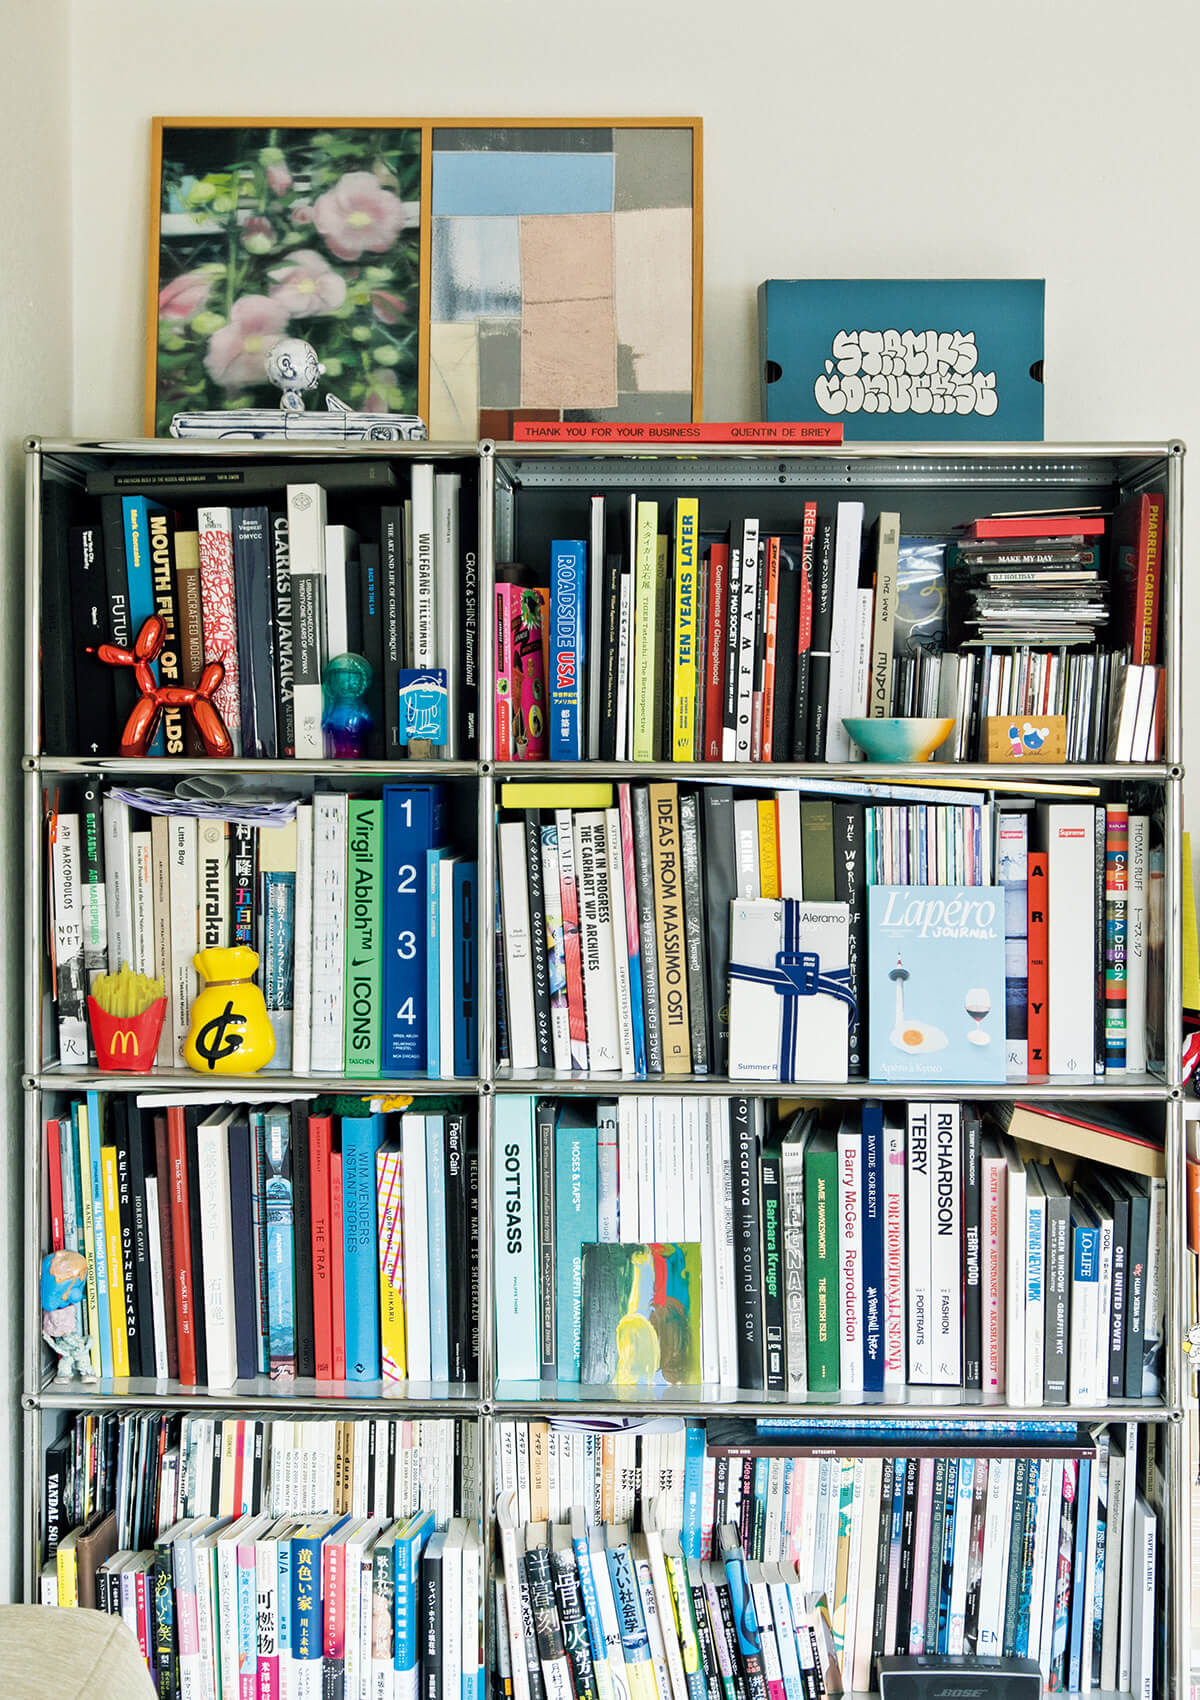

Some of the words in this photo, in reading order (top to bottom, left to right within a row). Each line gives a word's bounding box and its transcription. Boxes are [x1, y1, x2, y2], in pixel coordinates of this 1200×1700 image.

[525, 428, 559, 437] THANK
[563, 428, 587, 437] YOU
[591, 428, 610, 437] FOR
[616, 428, 644, 437] YOUR
[648, 428, 700, 437] BUSINESS
[731, 428, 777, 437] QUENTIN
[782, 428, 796, 437] DE
[801, 428, 831, 437] BRIEY
[273, 518, 291, 593] CLARKS
[681, 515, 693, 566] LATER
[1036, 554, 1053, 562] DAY
[418, 534, 430, 595] WOLFGANG
[465, 552, 475, 588] CRACK
[731, 549, 739, 580] SABER
[150, 516, 170, 591] MOUTH
[161, 652, 177, 678] OF
[186, 575, 197, 635] HANDCRAFTED
[277, 597, 291, 617] IN
[389, 588, 395, 597] OF
[557, 555, 575, 647] ROADSIDE
[679, 573, 692, 628] YEARS
[713, 565, 723, 616] Compliments
[730, 595, 738, 613] MAD
[419, 599, 431, 655] TILLMANS
[466, 598, 475, 627] SHINE
[714, 619, 722, 627] of
[679, 634, 691, 665] TEN
[729, 615, 737, 648] SOCIETY
[190, 638, 200, 672] MODERN
[276, 620, 295, 703] JAMAICA
[465, 629, 476, 686] International
[557, 653, 575, 688] USA
[711, 629, 721, 685] Chicagohoodz
[401, 799, 412, 827] 1
[657, 799, 675, 847] IDEAS
[60, 825, 70, 840] ARI
[177, 826, 185, 848] Little
[351, 810, 375, 862] Virgil
[580, 825, 591, 843] THE
[1059, 829, 1085, 838] Supreme
[1133, 823, 1143, 864] THOMAS
[177, 850, 186, 866] Boy
[582, 847, 595, 897] CARHARTT
[660, 852, 677, 899] FROM
[62, 845, 73, 910] MARCOPOULOS
[236, 823, 252, 947] 村上隆の五百羅
[398, 865, 417, 893] 2
[1113, 854, 1125, 930] CALIFRNIA
[1133, 868, 1143, 890] RUFF
[585, 901, 596, 920] WIP
[59, 925, 80, 934] NOT
[60, 937, 80, 946] YET
[397, 931, 416, 959] 3
[586, 924, 599, 971] ARCHIVES
[662, 904, 681, 984] MASSIMO
[1113, 935, 1123, 981] DESIGN
[353, 977, 371, 1050] ICONS
[397, 997, 416, 1024] 4
[667, 990, 683, 1026] OSTI
[738, 1063, 770, 1071] Summer
[736, 1099, 749, 1123] roy
[449, 1123, 459, 1149] Peter
[868, 1135, 877, 1168] DAVIDE
[912, 1114, 927, 1175] TERRY
[119, 1150, 129, 1204] PETER
[346, 1144, 357, 1197] INSTANT
[359, 1152, 369, 1181] WIM
[450, 1152, 460, 1175] Cain
[740, 1133, 752, 1207] decarava
[843, 1148, 856, 1186] Barry
[938, 1113, 953, 1236] RICHARDSON
[505, 1143, 522, 1254] SOTTSASS
[817, 1178, 825, 1200] JAMIE
[868, 1172, 877, 1218] SORRENTI
[888, 1193, 901, 1220] FOR
[135, 1196, 143, 1229] HORROR
[316, 1219, 324, 1242] THE
[347, 1201, 358, 1253] STORIES
[359, 1184, 370, 1245] WENDERS
[742, 1215, 754, 1238] the
[766, 1199, 777, 1251] Barbara
[817, 1202, 826, 1258] HAWKESWORTH
[844, 1191, 857, 1239] McGee
[136, 1231, 145, 1262] CAVIAR
[1058, 1220, 1066, 1252] BROKEN
[1081, 1232, 1092, 1277] LO-LIFE
[1103, 1229, 1111, 1251] POOL
[316, 1248, 325, 1279] TRAP
[743, 1247, 757, 1292] sound
[887, 1222, 902, 1313] PROMOTIONAL
[967, 1226, 978, 1285] TERRYWOOD
[1057, 1254, 1065, 1293] WINDOWS
[1114, 1246, 1124, 1268] ONE
[123, 1228, 136, 1336] SUTHERLAND
[766, 1253, 778, 1297] Kruger
[1113, 1272, 1123, 1309] UNITED
[844, 1250, 858, 1342] Reproduction
[941, 1295, 949, 1334] FASHION
[746, 1313, 757, 1342] saw
[889, 1314, 901, 1338] USE
[916, 1295, 925, 1345] PORTRAITS
[1112, 1313, 1122, 1351] POWER
[888, 1341, 901, 1371] ONLY
[907, 1462, 915, 1480] idea
[47, 1474, 59, 1525] VANDAL
[48, 1526, 58, 1558] SQUA
[280, 1552, 288, 1574] N/A
[298, 1549, 312, 1611] 黄色い家
[257, 1589, 274, 1654] 可燃物
[300, 1618, 308, 1659] 川上未映
[936, 1689, 988, 1697] BOSE
